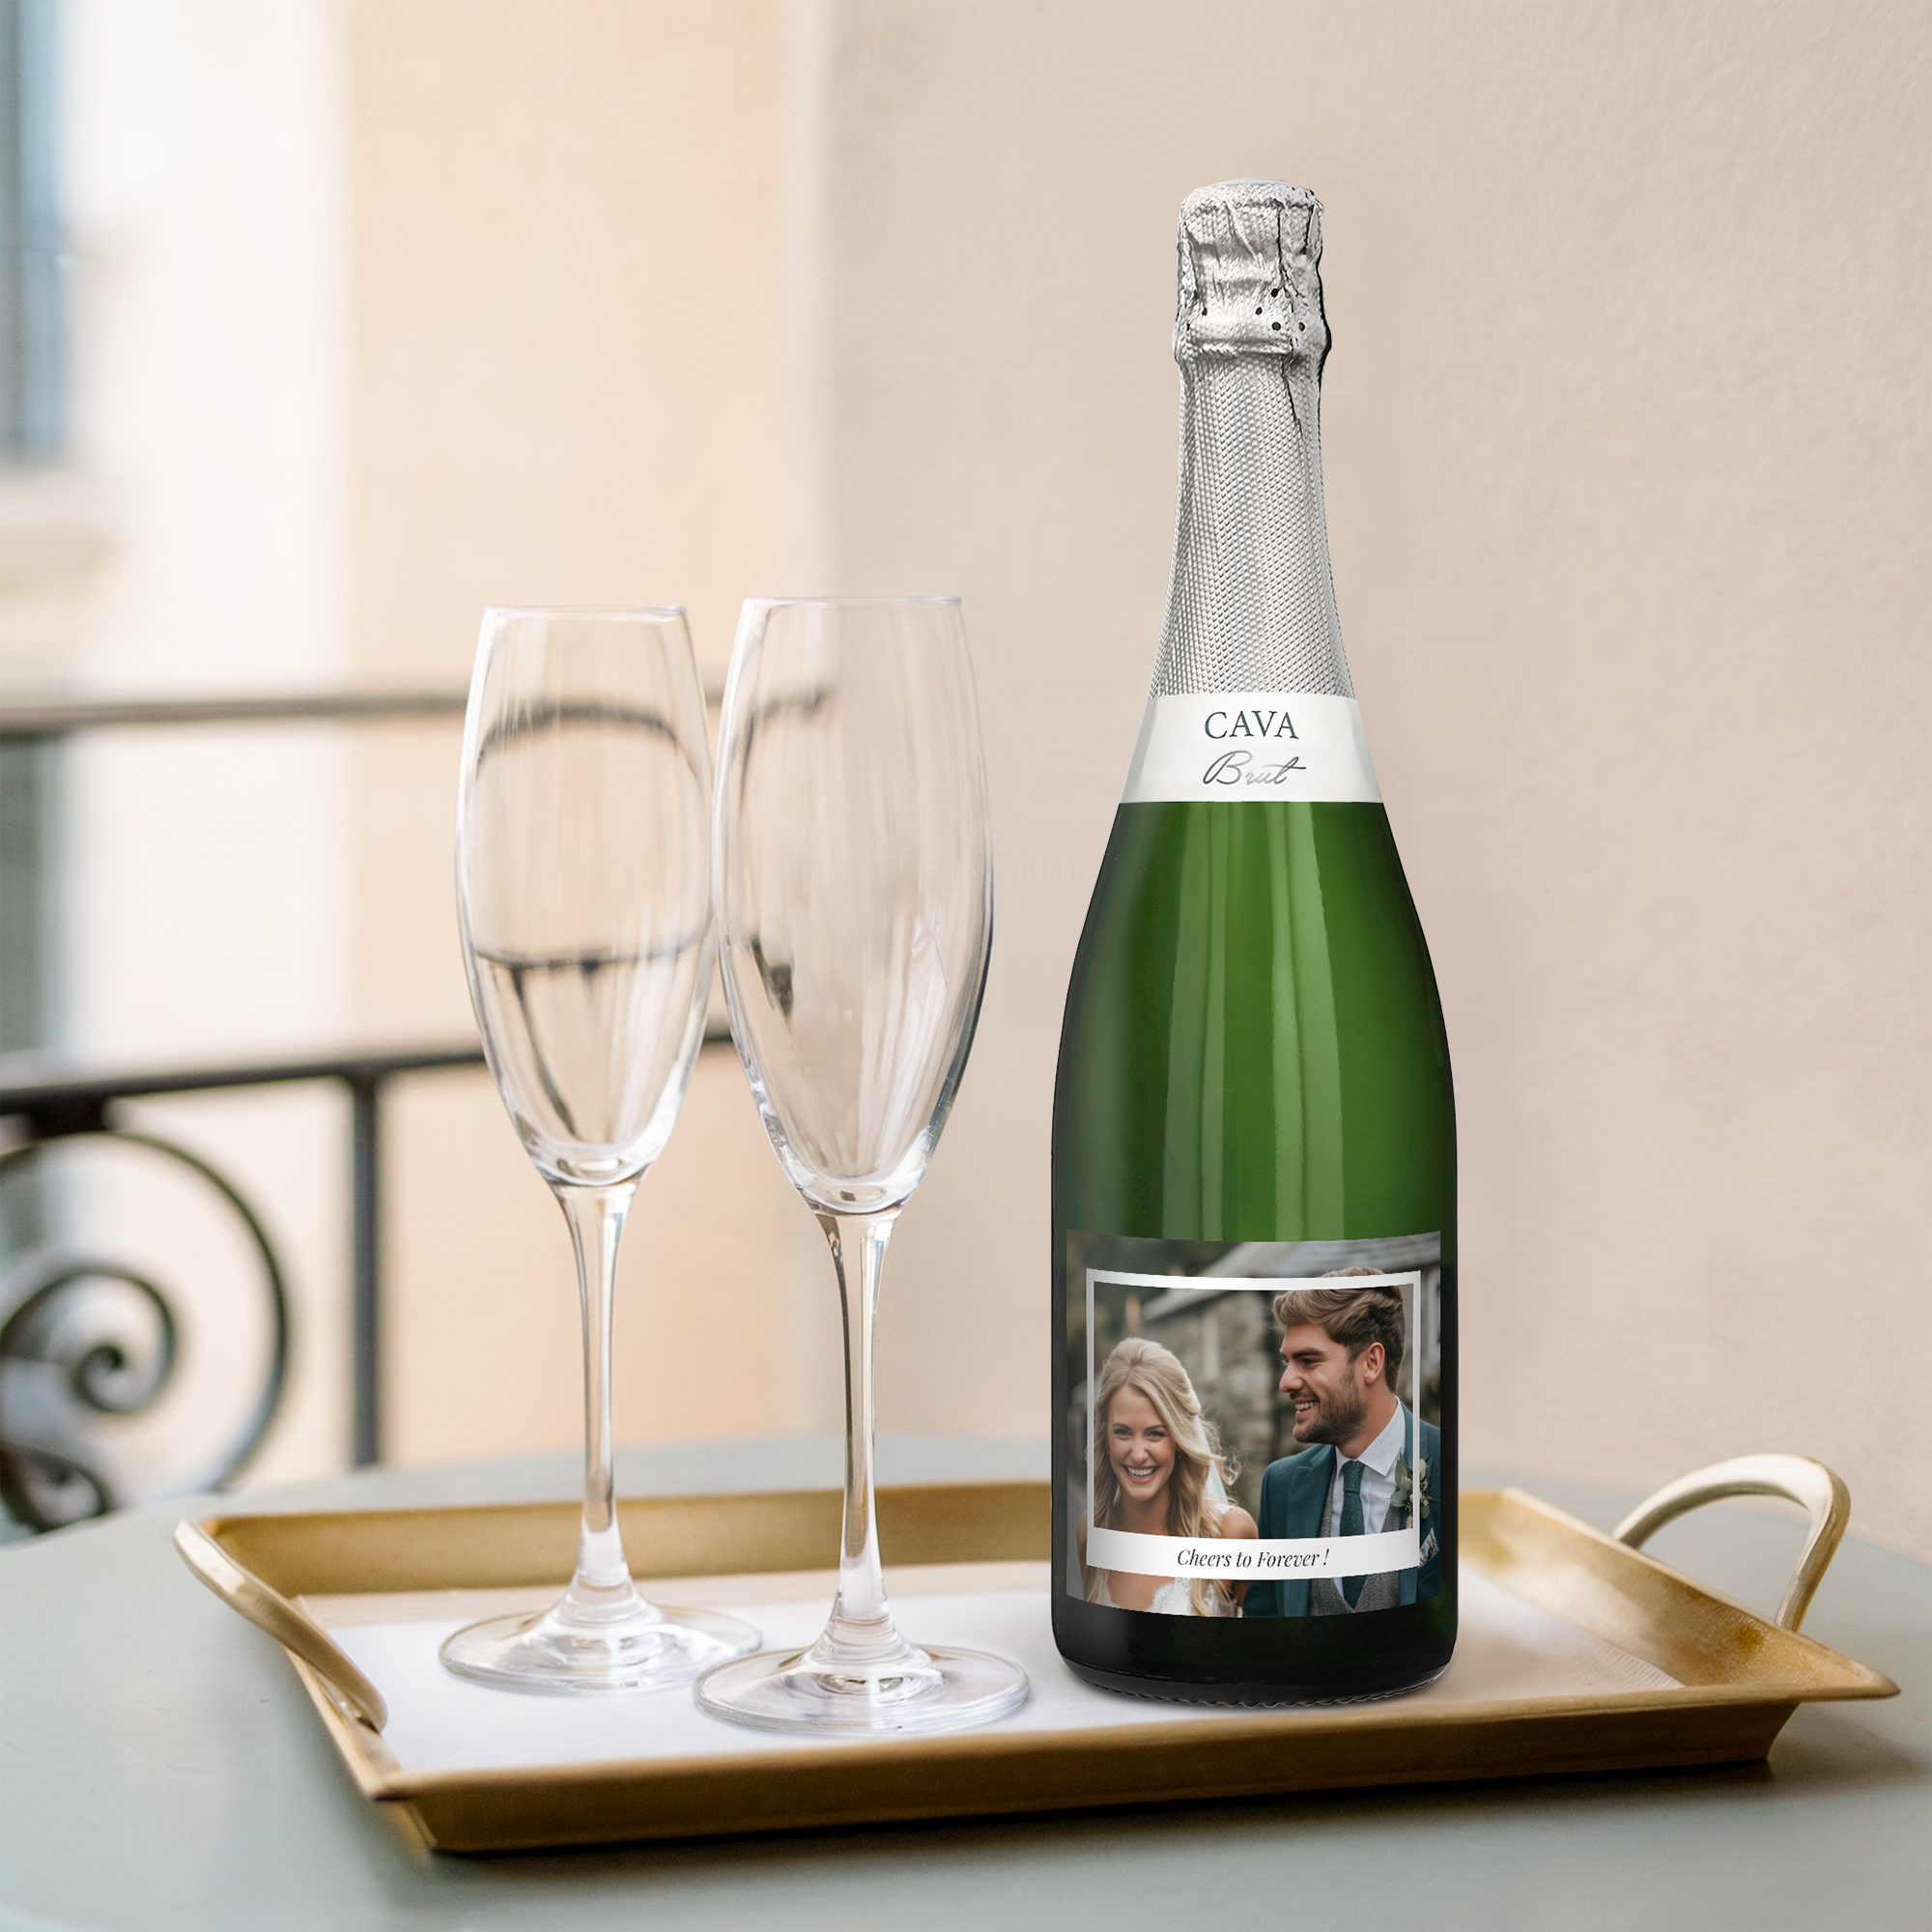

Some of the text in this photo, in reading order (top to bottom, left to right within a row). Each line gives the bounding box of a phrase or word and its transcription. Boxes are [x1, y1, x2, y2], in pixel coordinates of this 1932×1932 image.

[1204, 710, 1299, 740] CAVA
[1203, 750, 1307, 784] Brut
[1177, 1548, 1232, 1567] Cheers
[1236, 1551, 1252, 1568] to
[1257, 1551, 1320, 1568] Forever
